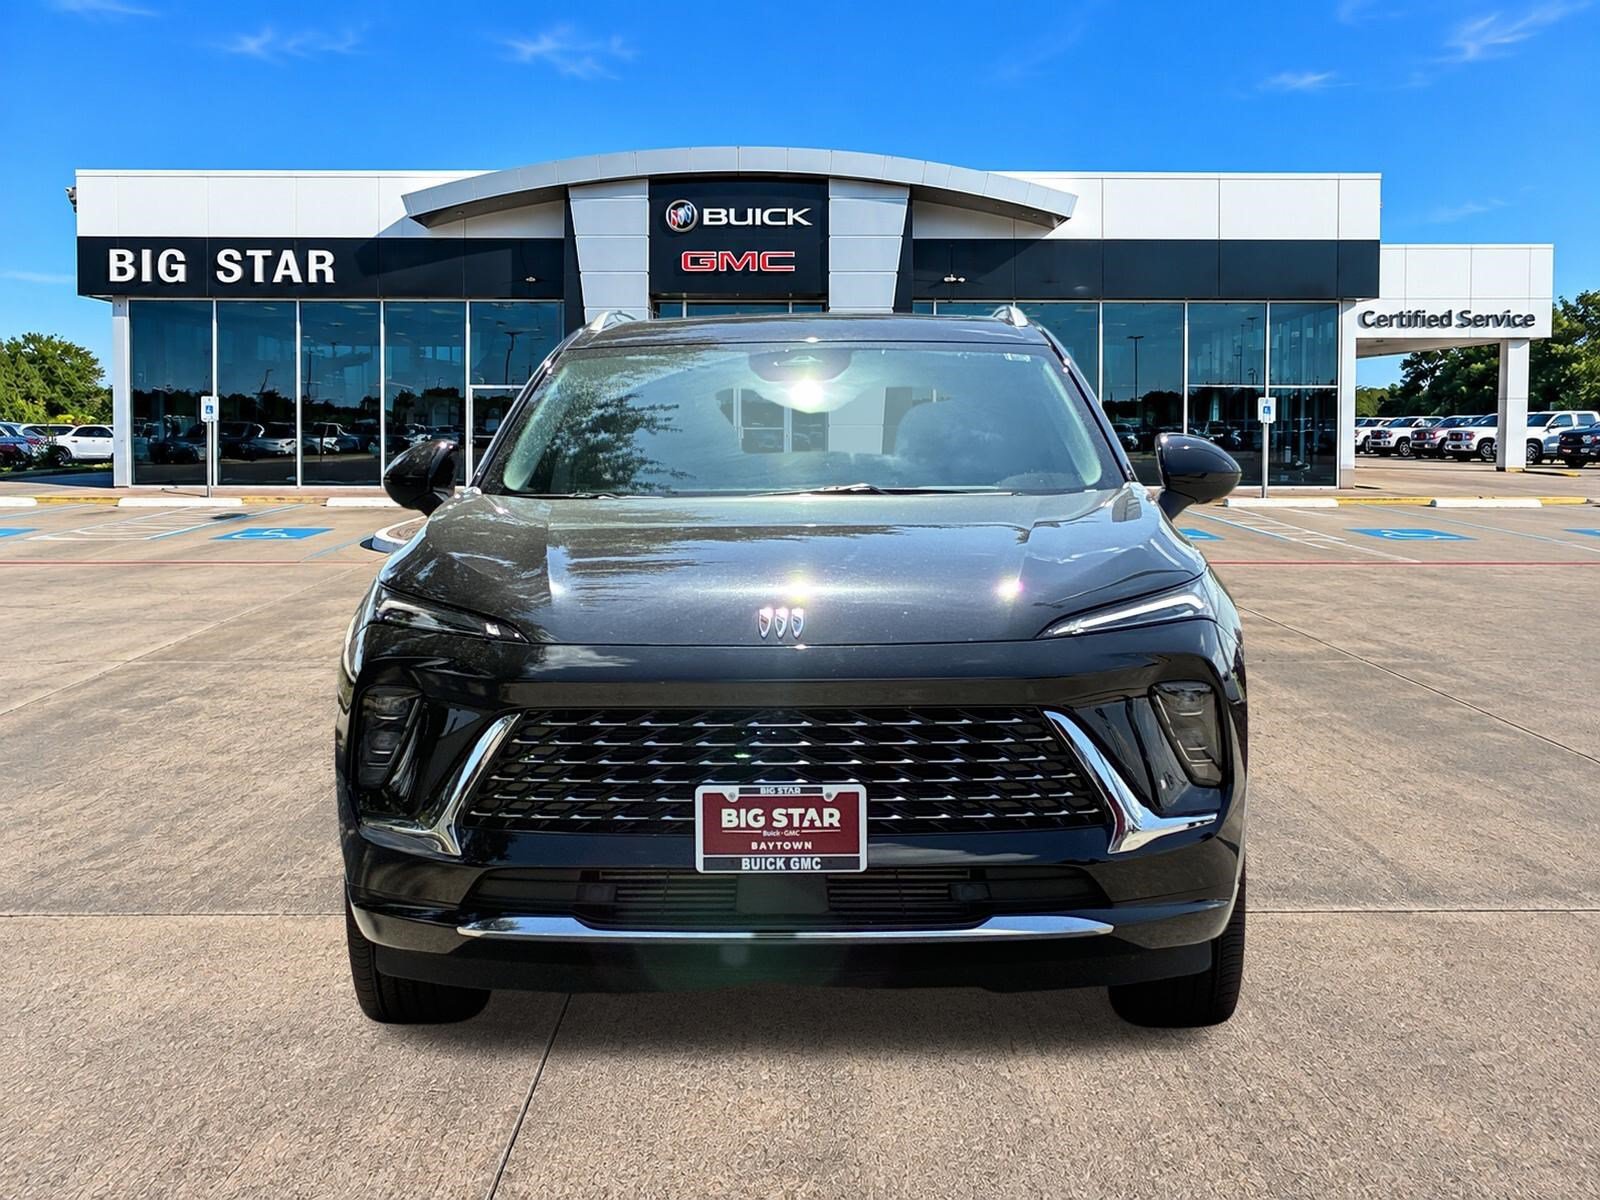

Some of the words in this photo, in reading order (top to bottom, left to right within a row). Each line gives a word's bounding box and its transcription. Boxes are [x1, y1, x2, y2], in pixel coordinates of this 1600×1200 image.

[703, 208, 813, 226] BUICK
[108, 248, 188, 283] BIG
[216, 248, 336, 284] STAR
[681, 251, 796, 272] GMC
[1358, 309, 1453, 329] Certified
[1454, 309, 1536, 329] Service
[721, 808, 766, 828] BIG
[772, 807, 841, 828] STAR
[751, 841, 812, 850] BAYTOWN
[741, 857, 786, 870] BUICK
[790, 857, 822, 870] GMC
